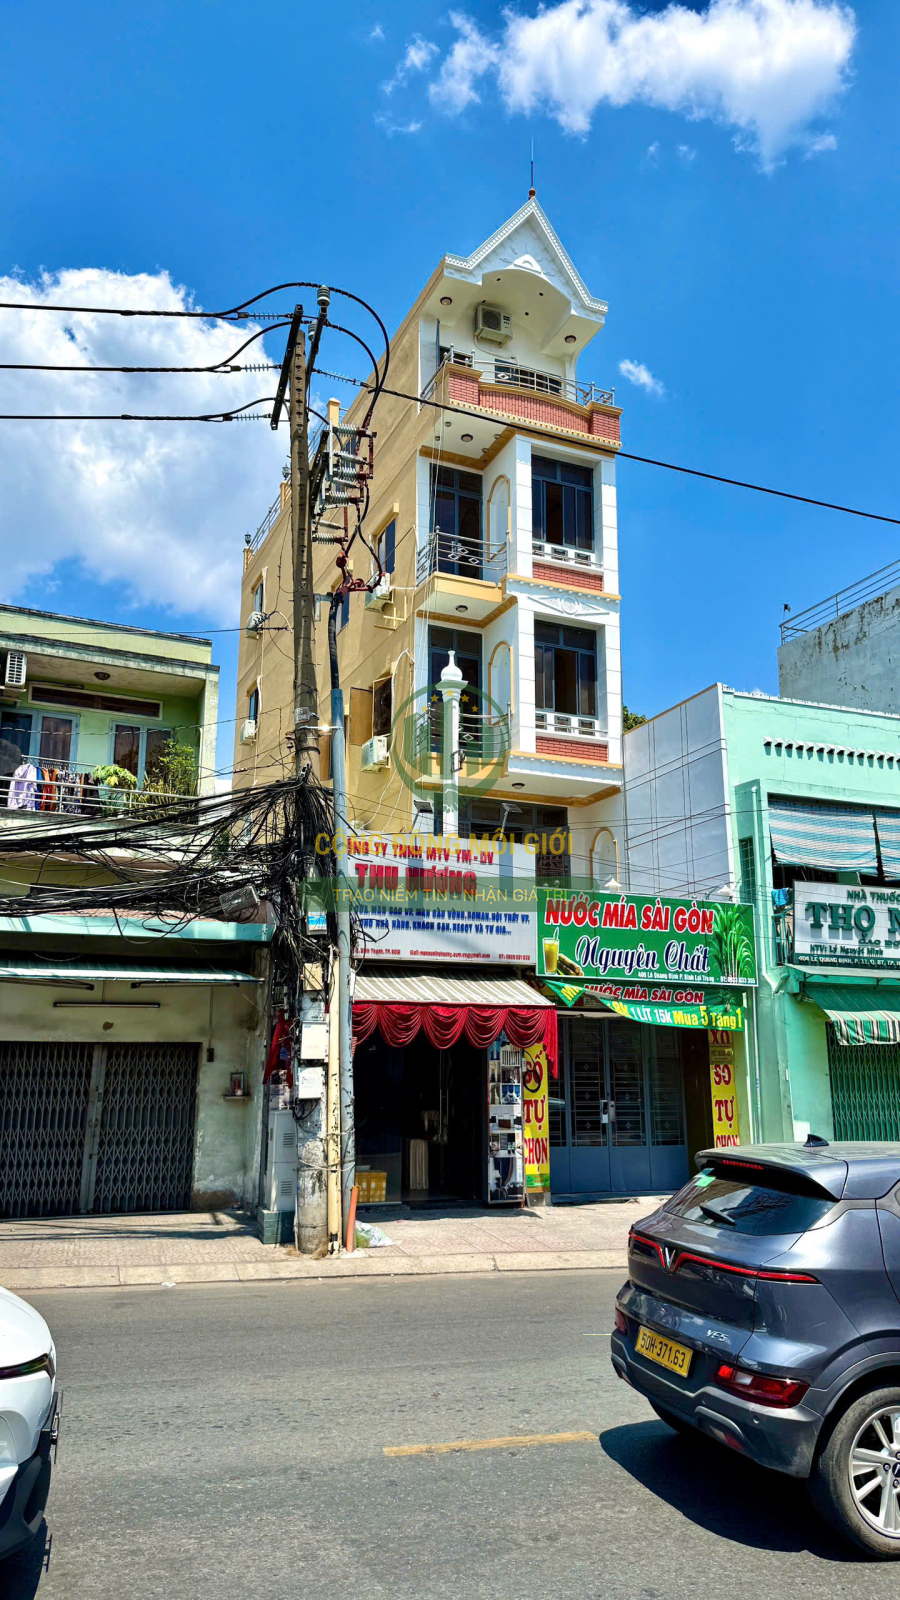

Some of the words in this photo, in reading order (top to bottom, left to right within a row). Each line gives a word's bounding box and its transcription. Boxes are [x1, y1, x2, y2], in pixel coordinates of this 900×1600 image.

[355, 863, 399, 891] THU
[405, 865, 477, 896] HƯƠNG
[847, 889, 867, 901] NHÀ
[544, 892, 600, 928] NƯỚC
[602, 895, 638, 930] MÍA
[641, 898, 671, 932] SÀI
[674, 901, 714, 934] GÒN
[805, 902, 876, 938] THỌ
[575, 935, 659, 975] Nguyên
[664, 940, 710, 973] Chất
[650, 986, 673, 1002] SÀI
[674, 988, 704, 1004] GÒN
[672, 1011, 699, 1026] Mua
[700, 1005, 709, 1026] 5
[710, 1012, 736, 1030] Tặng
[736, 1008, 742, 1028] 1
[524, 1094, 546, 1131] TỰ
[714, 1095, 734, 1128] TỰ
[640, 1333, 686, 1369] 50H-371.63
